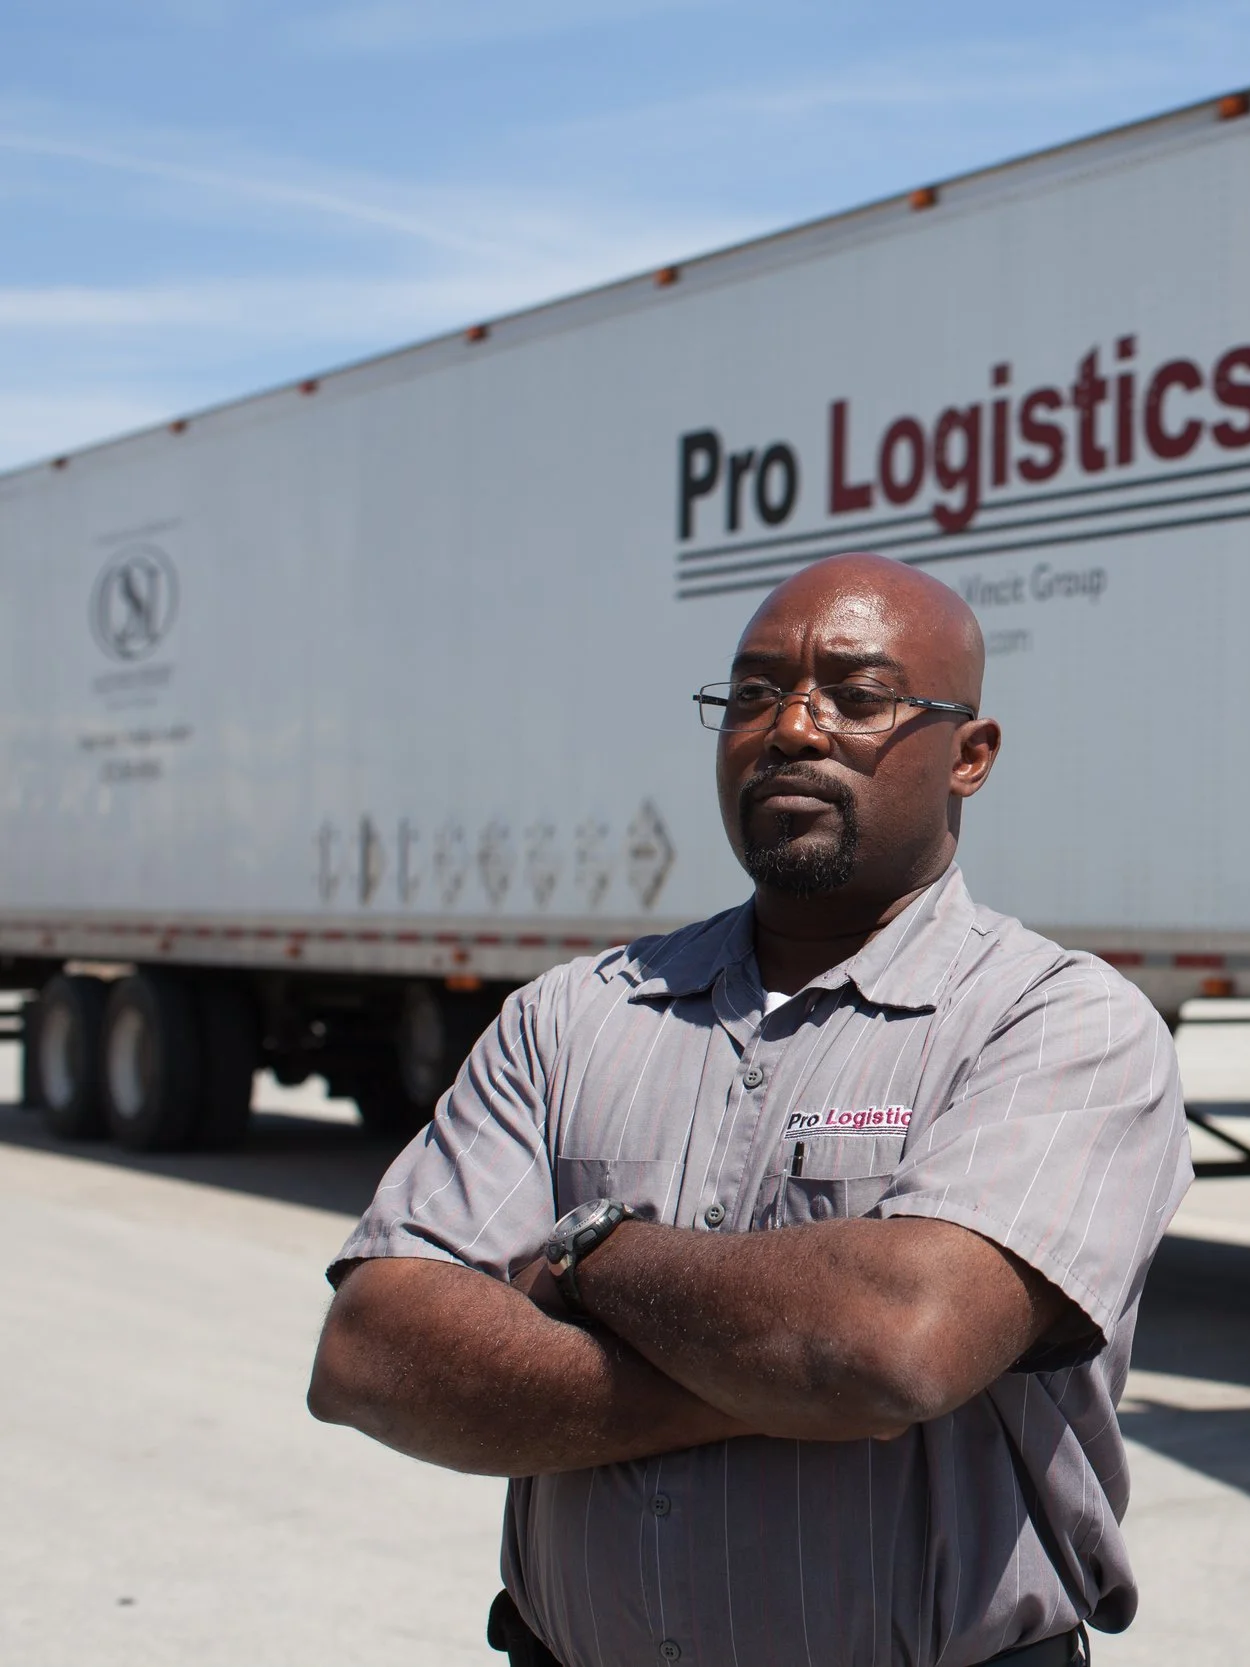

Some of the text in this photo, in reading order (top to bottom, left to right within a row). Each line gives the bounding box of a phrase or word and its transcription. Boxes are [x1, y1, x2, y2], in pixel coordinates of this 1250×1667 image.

[678, 428, 800, 542] Pro
[1030, 562, 1108, 606] Group
[787, 1106, 912, 1130] Pro Logistic
